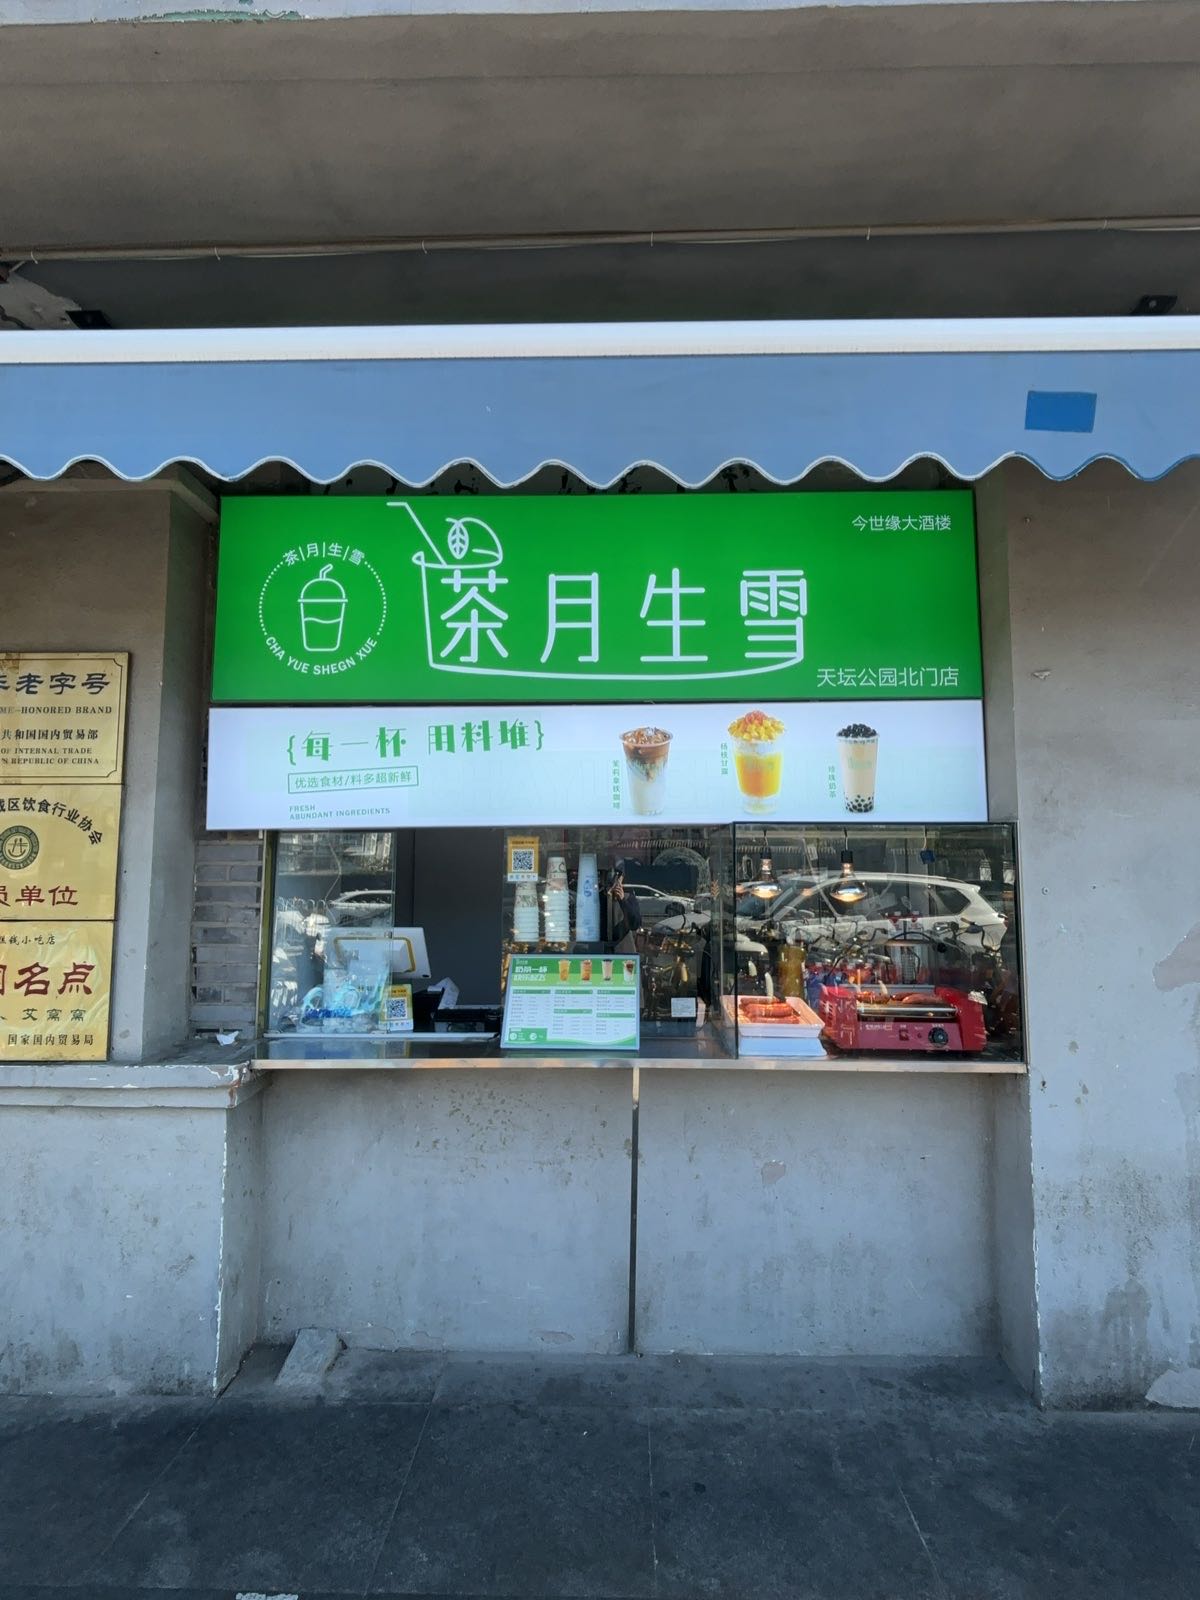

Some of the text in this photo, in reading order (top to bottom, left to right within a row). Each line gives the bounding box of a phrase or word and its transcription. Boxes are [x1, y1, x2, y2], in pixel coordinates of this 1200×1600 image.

[851, 514, 952, 532] 今世缘大酒楼
[440, 567, 808, 664] 茶月生雪
[265, 635, 378, 676] CHA YUE SHEGN XUE
[816, 666, 960, 688] 天坛公园北门店
[75, 705, 113, 715] BRAND
[2, 729, 99, 741] 共和国国内贸易部
[14, 747, 60, 755] INTERNAL
[63, 747, 93, 755] TRADE
[11, 757, 55, 765] REPUBLIC
[57, 757, 69, 765] OF
[71, 757, 100, 765] CHINA
[294, 770, 413, 790] 优选食材/料多超新鲜
[289, 803, 316, 813] FRESH
[289, 807, 391, 821] ABUNDANT INGREDIENTS
[0, 961, 96, 997] 名点
[7, 1033, 95, 1047] 国家国内贸易局
